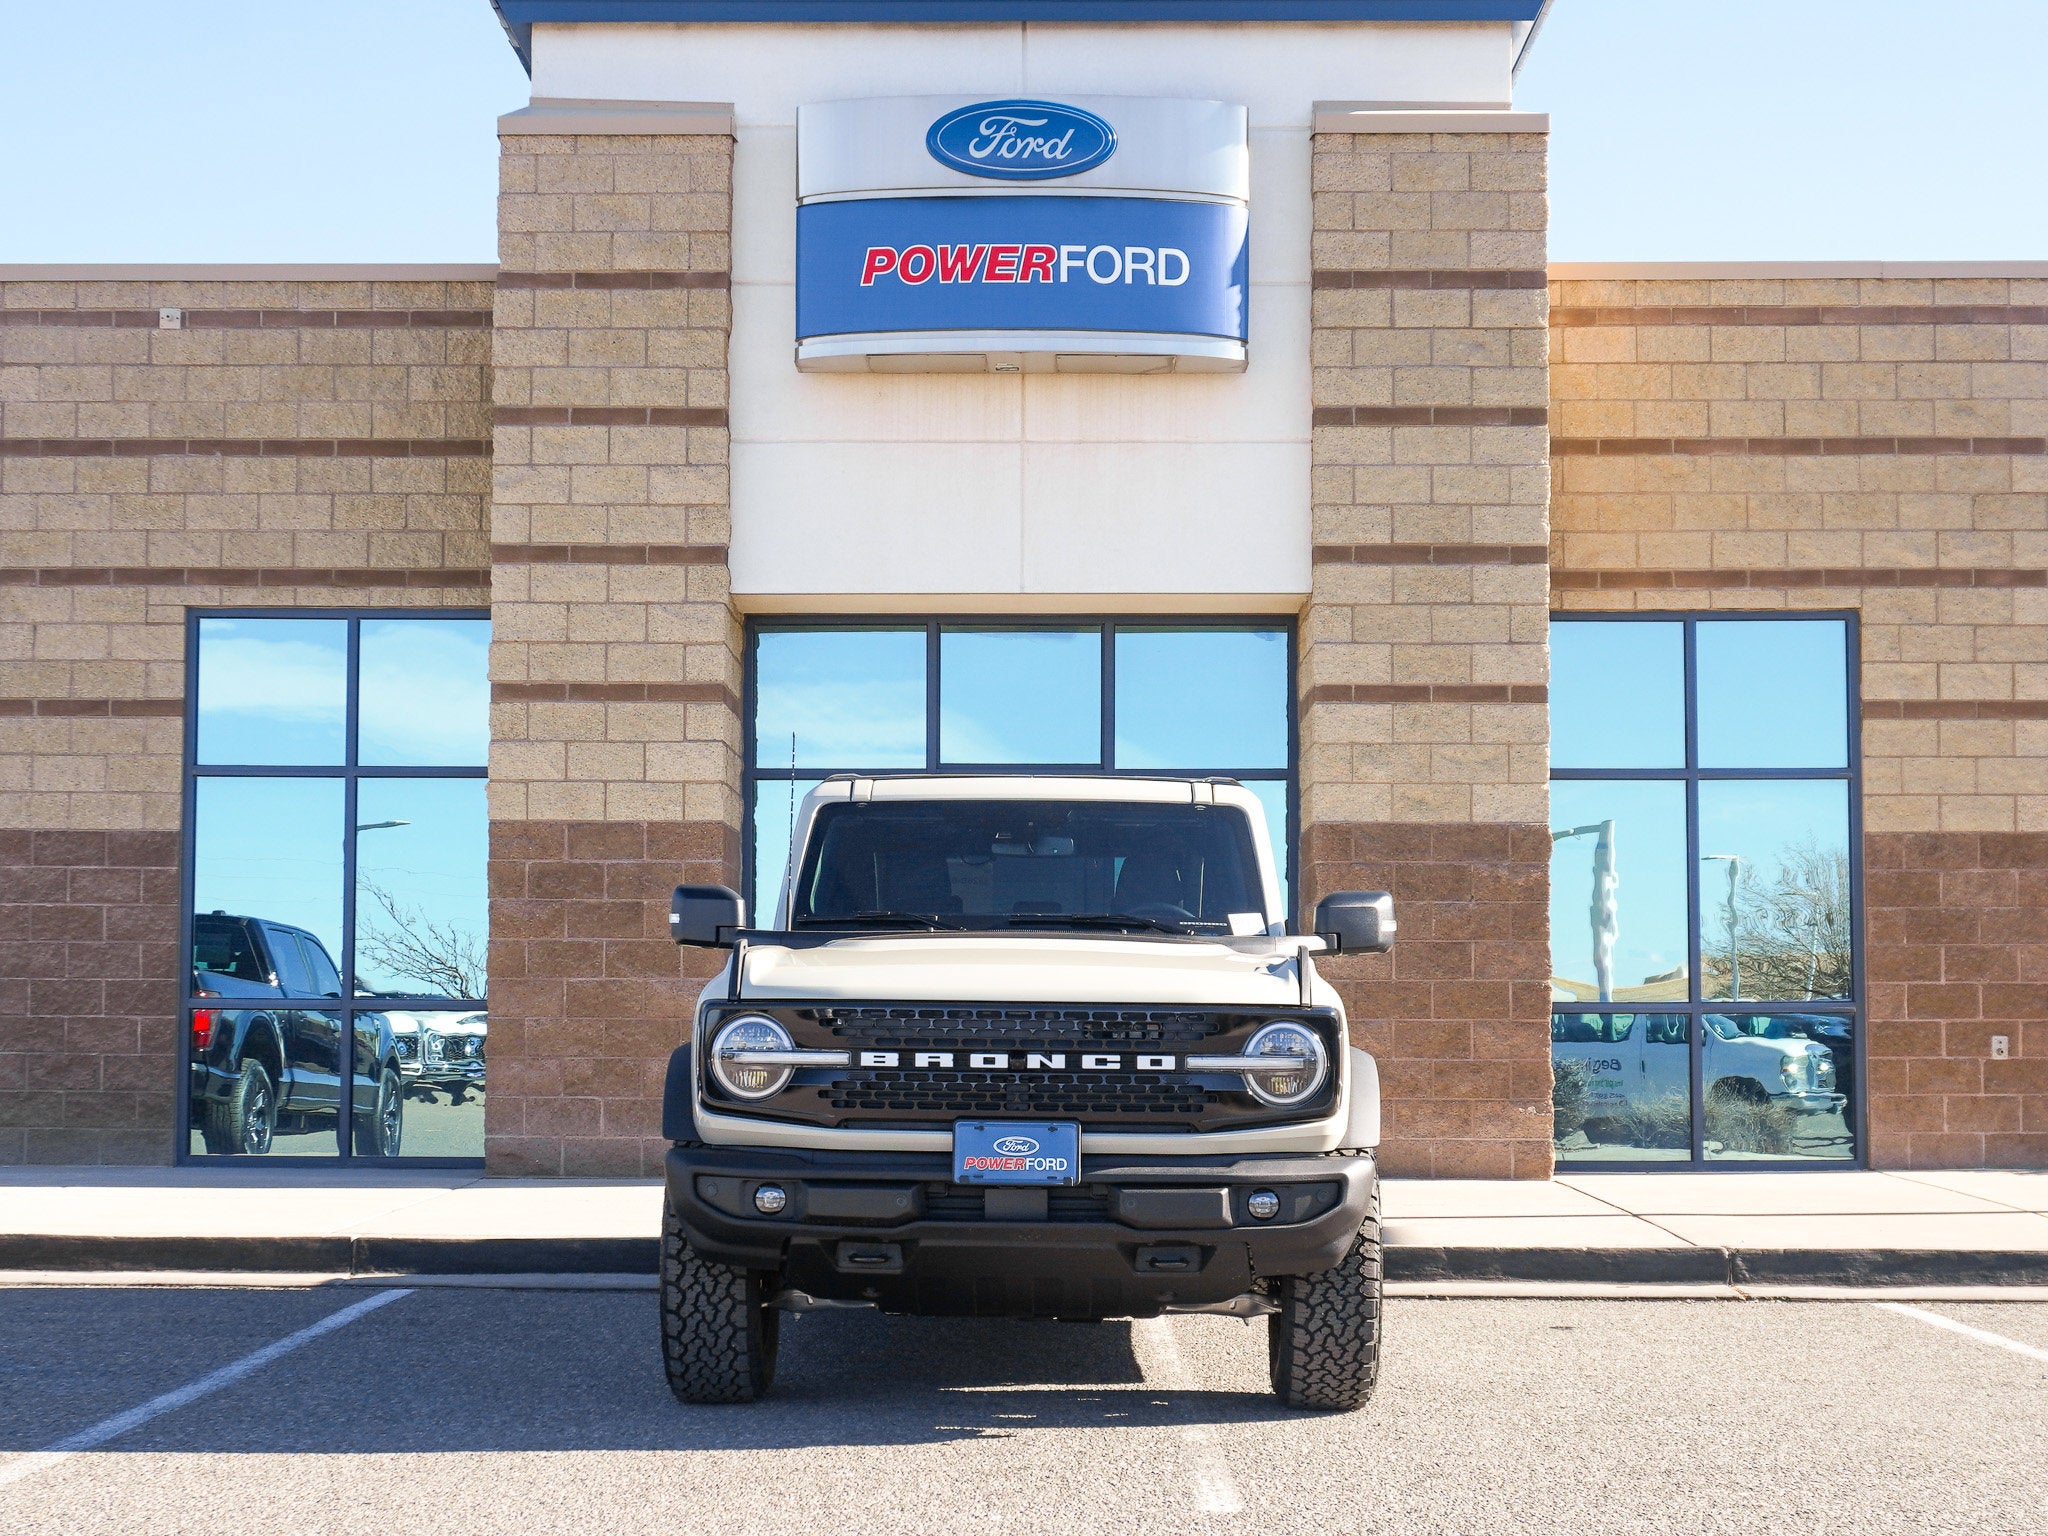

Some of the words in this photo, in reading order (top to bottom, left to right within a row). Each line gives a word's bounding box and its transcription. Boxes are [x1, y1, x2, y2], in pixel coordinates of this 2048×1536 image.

[968, 115, 1074, 160] Ford
[860, 1052, 1176, 1071] BRONCO
[1002, 1140, 1030, 1152] Ford
